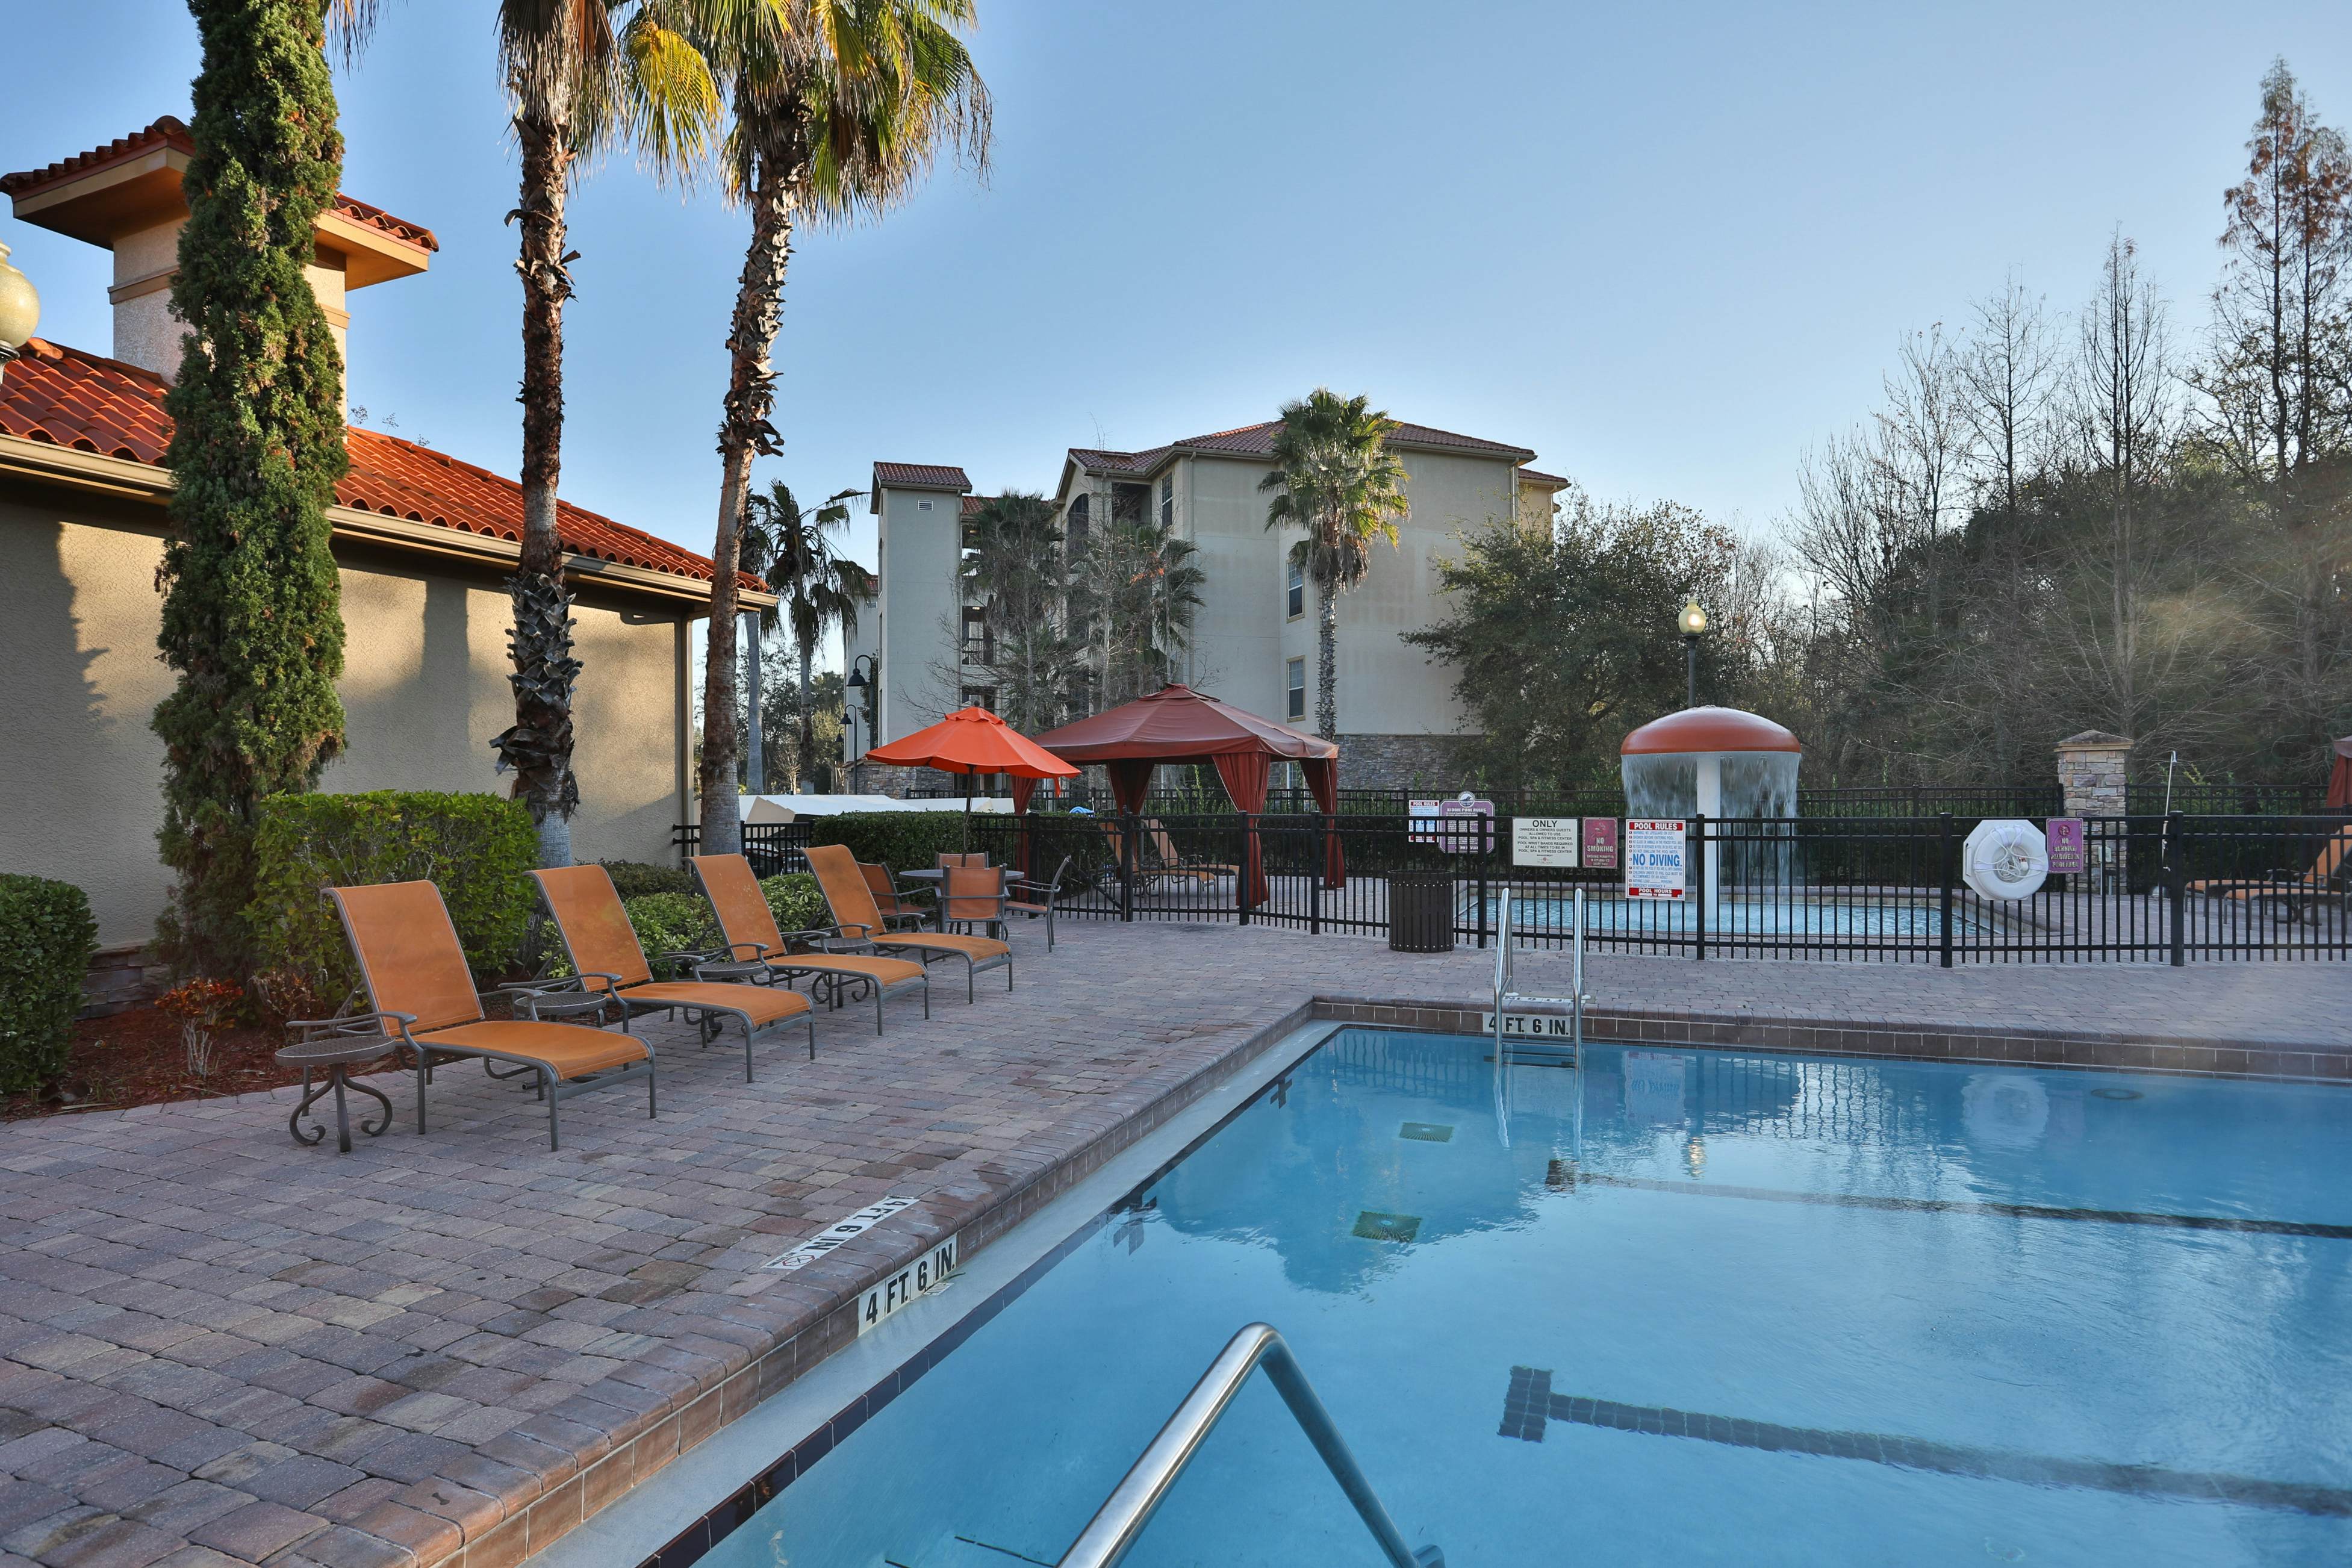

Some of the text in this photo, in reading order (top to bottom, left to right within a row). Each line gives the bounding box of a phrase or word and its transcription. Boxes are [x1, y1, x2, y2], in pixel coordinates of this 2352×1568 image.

[1632, 853, 1682, 867] NO DIVING.
[1489, 1016, 1569, 1035] 4 FT. 6 IN.
[835, 1225, 862, 1233] 6
[802, 1237, 845, 1251] IN.
[866, 1243, 956, 1325] 4 FT. 6 IN.
